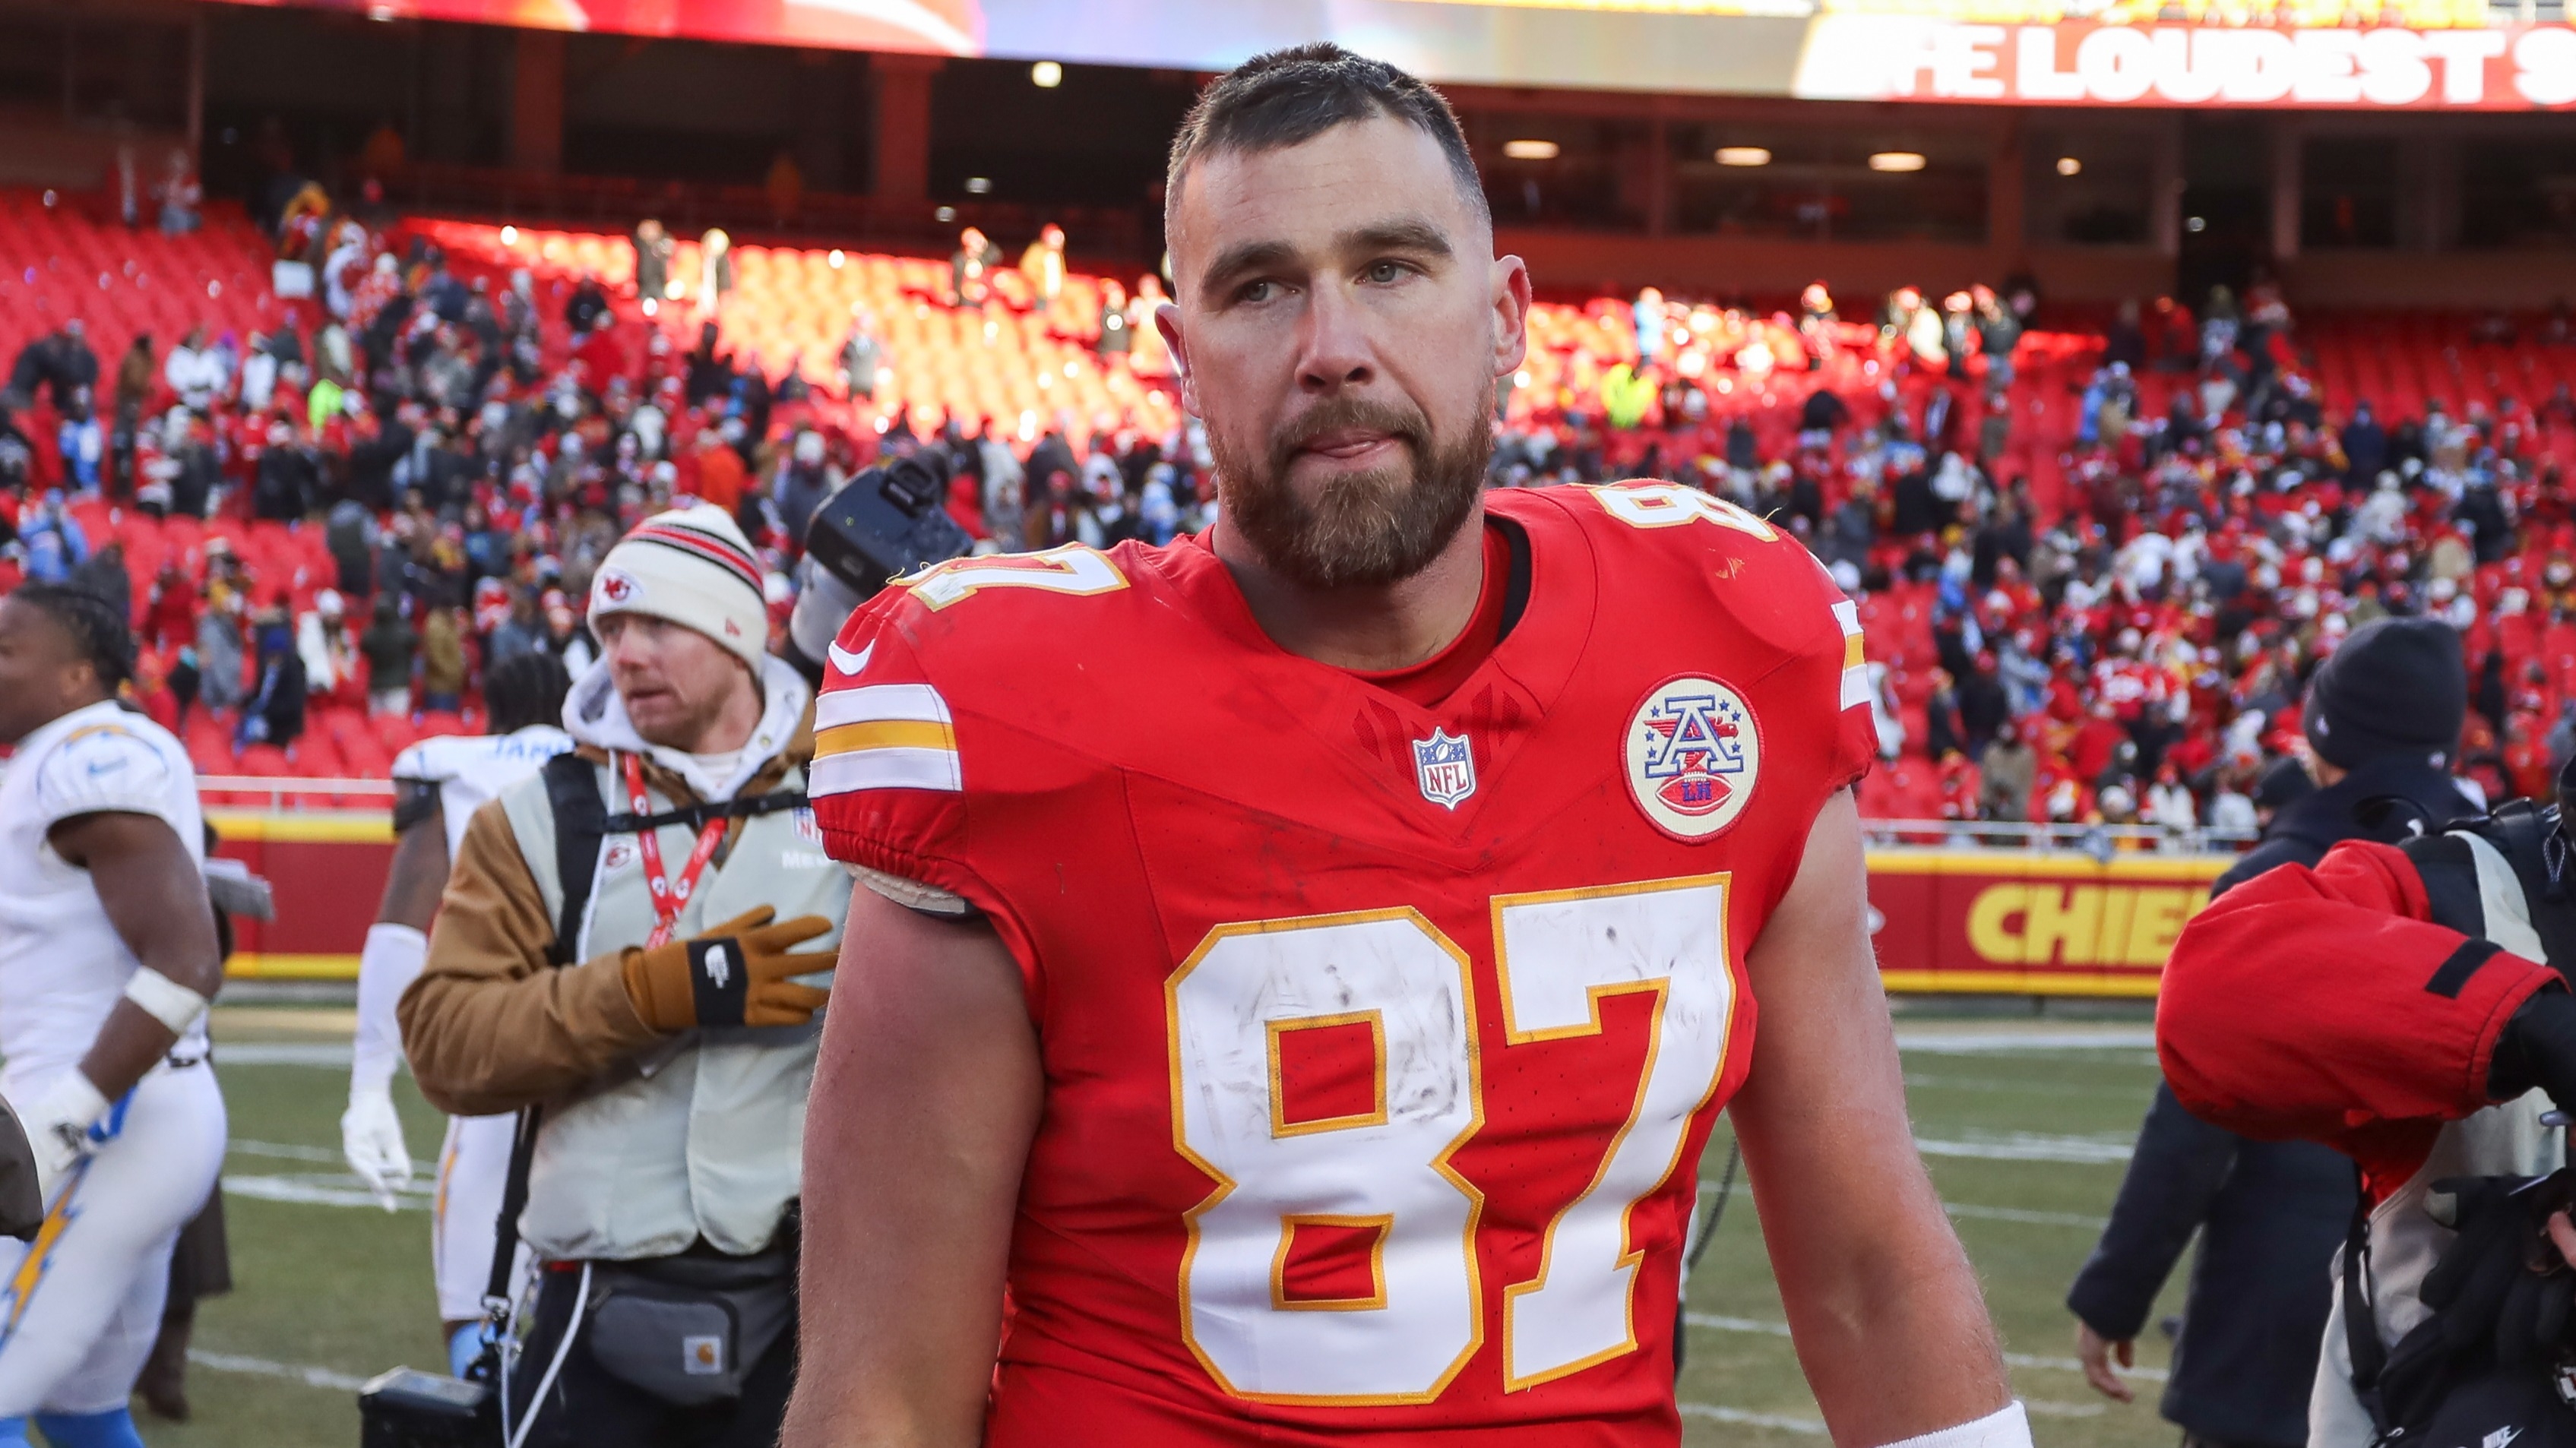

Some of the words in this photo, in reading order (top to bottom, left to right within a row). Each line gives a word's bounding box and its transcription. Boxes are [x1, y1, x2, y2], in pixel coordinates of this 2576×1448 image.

[1854, 24, 2005, 97] HE
[2017, 26, 2507, 104] LOUDEST
[1426, 764, 1467, 795] NFL
[1680, 781, 1713, 801] LH
[1966, 881, 2211, 967] CHIE
[1164, 871, 1736, 1405] 87
